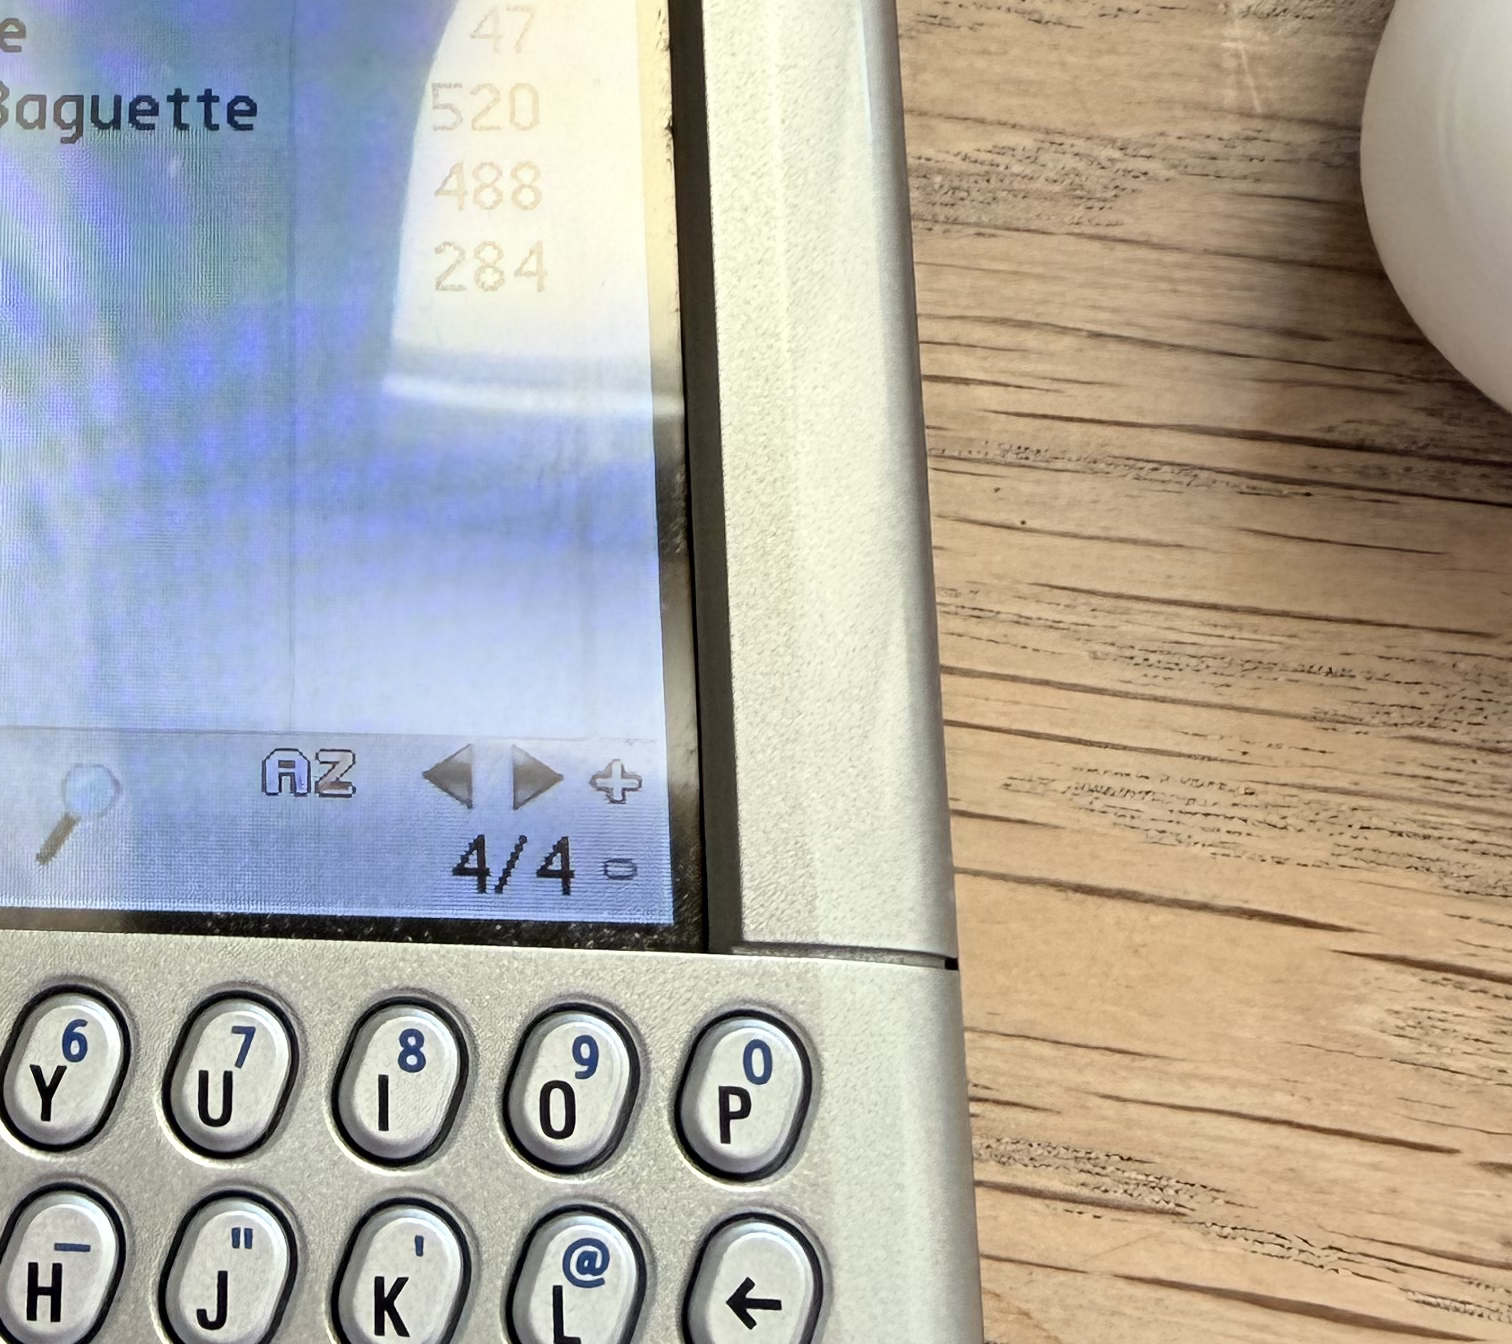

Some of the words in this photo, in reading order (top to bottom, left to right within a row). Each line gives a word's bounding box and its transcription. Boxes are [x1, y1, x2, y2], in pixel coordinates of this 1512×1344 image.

[468, 5, 536, 53] 47
[430, 82, 541, 131] 520
[434, 161, 543, 211] 488
[433, 241, 548, 293] 284
[452, 834, 574, 895] 4/4
[63, 1021, 87, 1061] 6
[232, 1027, 256, 1068] 7
[399, 1030, 425, 1072] 8
[573, 1036, 598, 1078] 9
[744, 1040, 771, 1084] 0
[30, 1065, 67, 1121] Y
[198, 1070, 232, 1127] U
[379, 1075, 388, 1131] I
[540, 1081, 575, 1139] O
[719, 1086, 751, 1144] P
[27, 1262, 62, 1322] H
[197, 1271, 227, 1330] J
[375, 1277, 409, 1337] K
